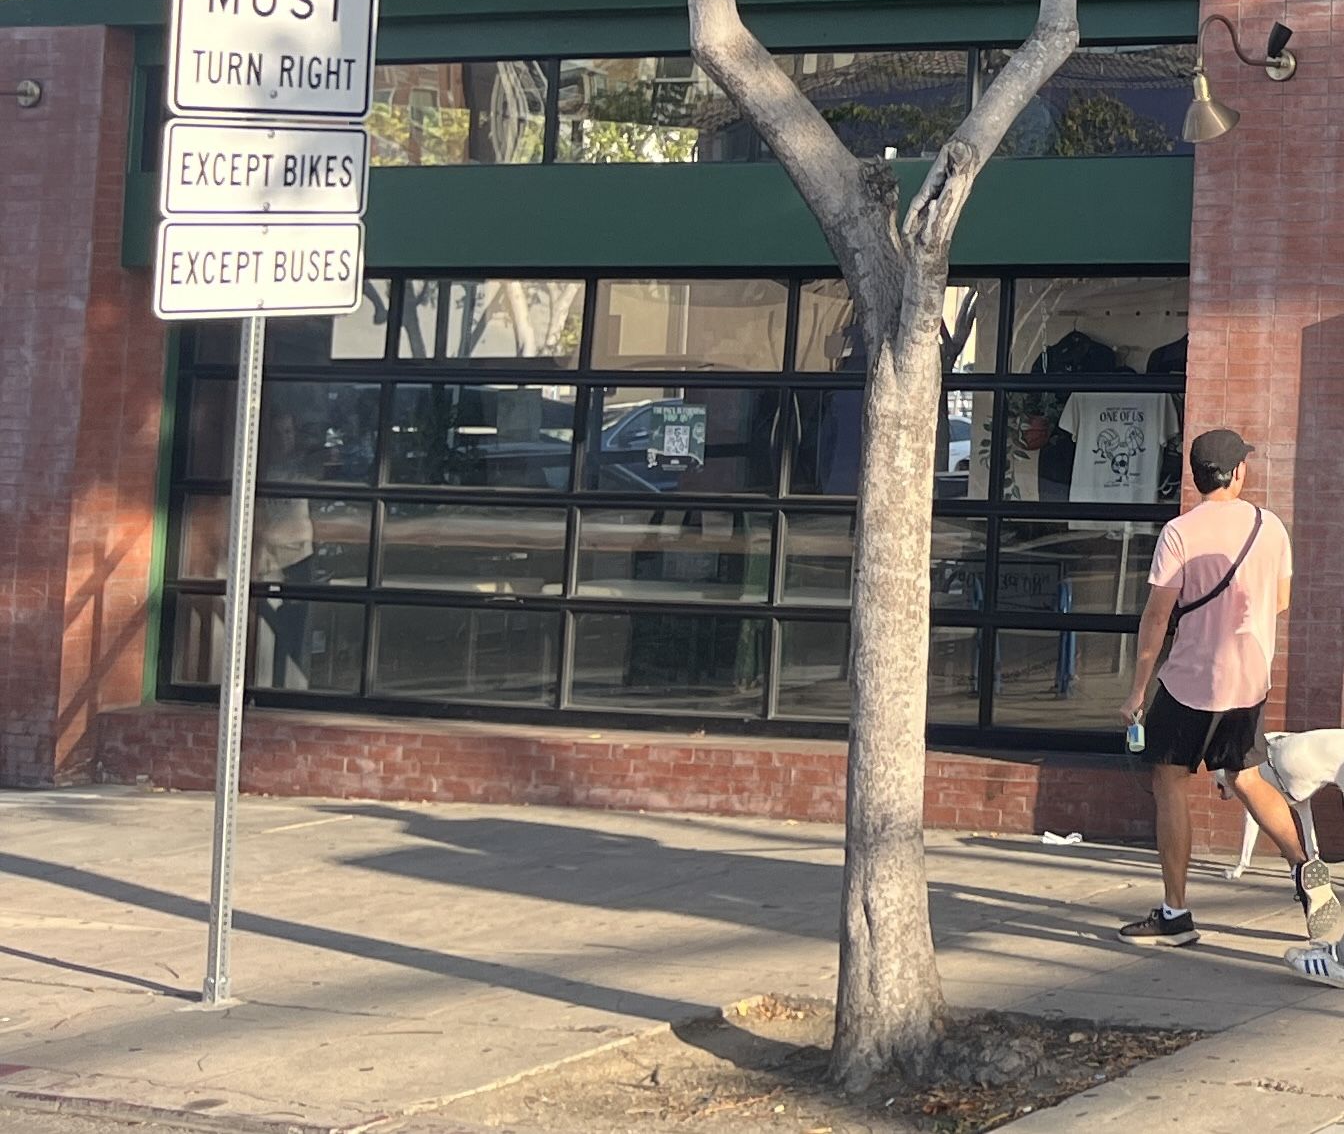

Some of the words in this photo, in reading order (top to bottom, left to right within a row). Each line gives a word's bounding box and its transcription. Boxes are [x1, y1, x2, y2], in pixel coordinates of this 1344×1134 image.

[193, 50, 263, 88] TURN
[280, 54, 357, 92] RIGHT
[181, 152, 274, 188] EXCEPT
[283, 153, 353, 190] BIKES
[171, 248, 263, 285] EXCEPT
[273, 248, 351, 285] BUSES
[1100, 411, 1118, 422] ONE
[1119, 411, 1131, 422] OF
[1132, 411, 1145, 422] US
